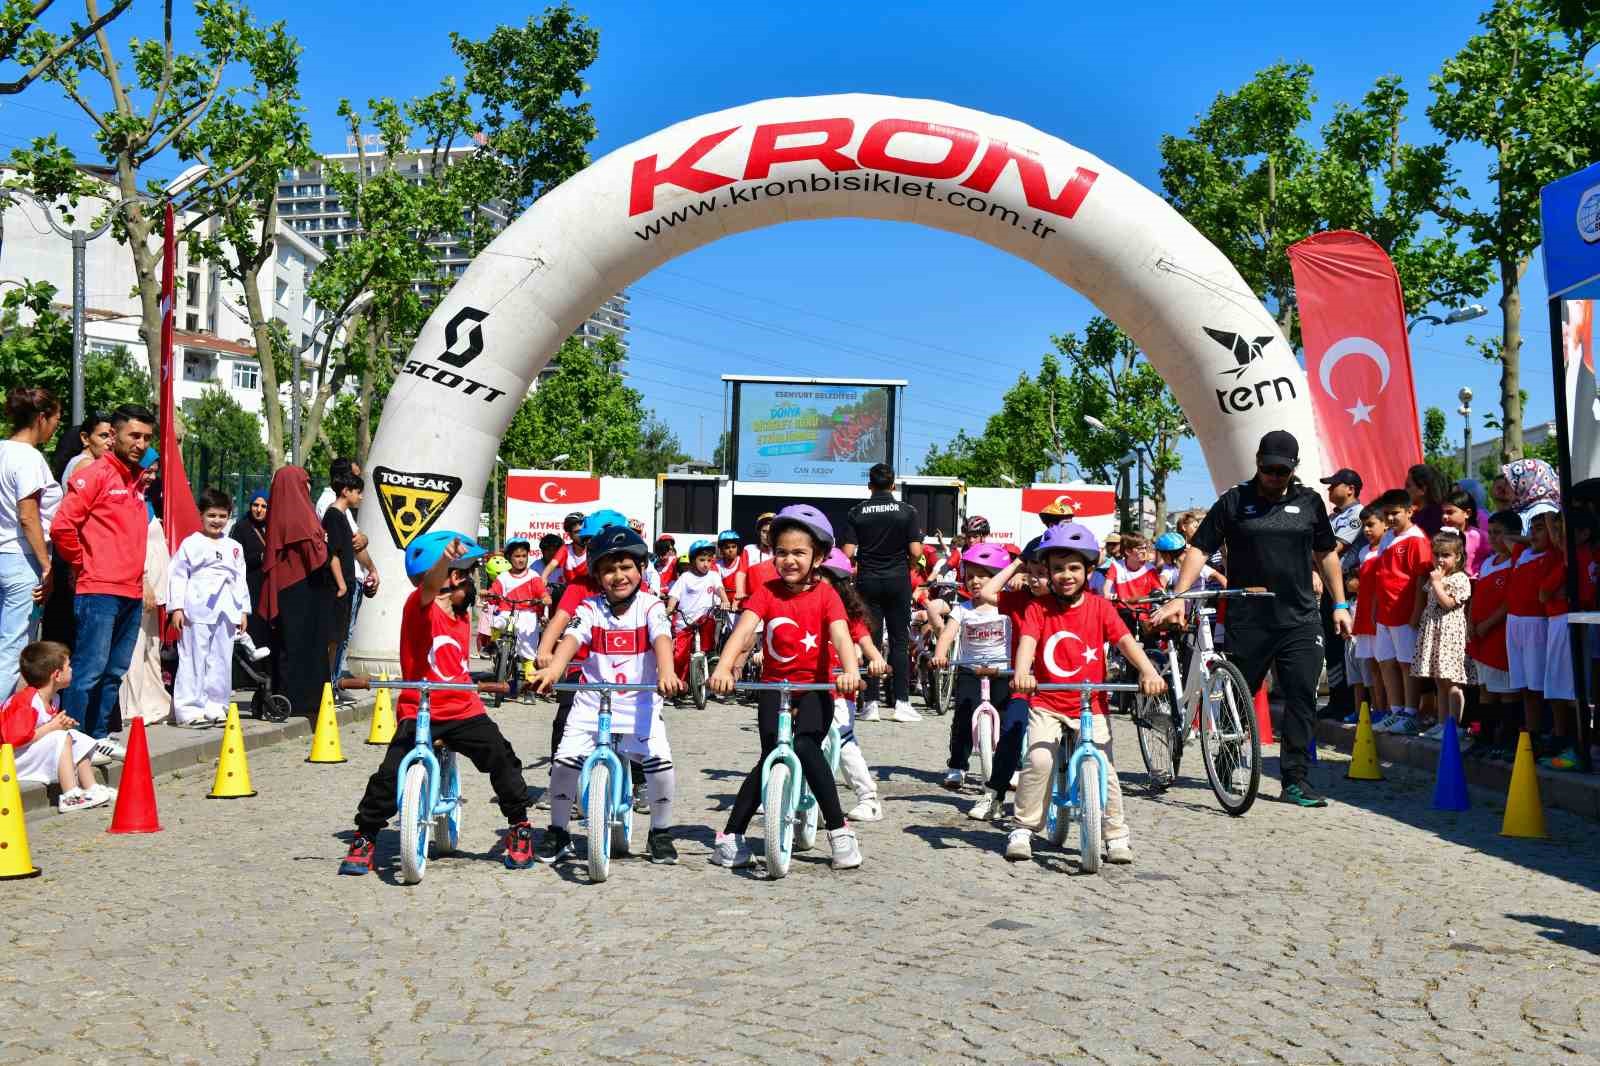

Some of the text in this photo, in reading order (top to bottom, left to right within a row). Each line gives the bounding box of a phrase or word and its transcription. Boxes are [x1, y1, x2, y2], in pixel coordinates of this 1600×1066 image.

[628, 117, 1099, 218] KRON
[634, 172, 1056, 242] www.kronbisiklet.com.tr
[402, 360, 506, 402] SCOTT
[1215, 376, 1297, 415] tern
[381, 472, 450, 491] TOPEAK
[861, 502, 900, 514] ANTRENÖR
